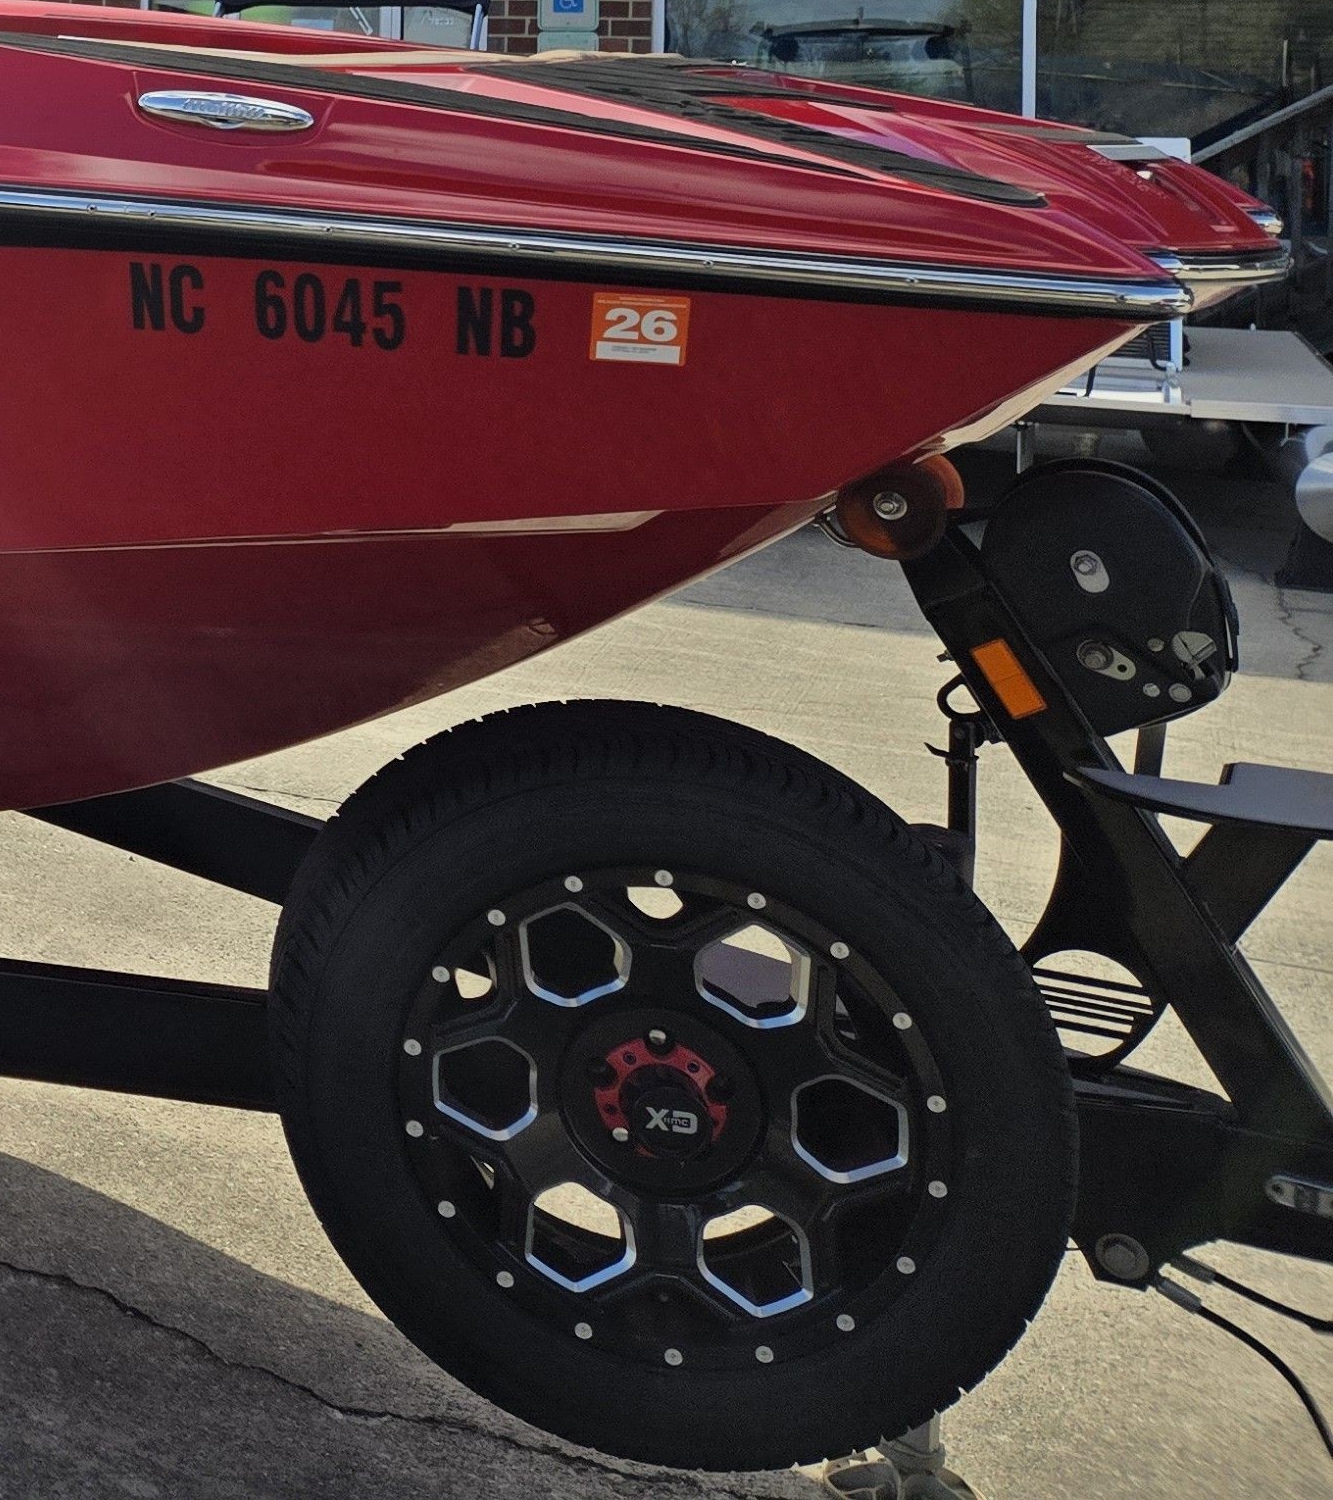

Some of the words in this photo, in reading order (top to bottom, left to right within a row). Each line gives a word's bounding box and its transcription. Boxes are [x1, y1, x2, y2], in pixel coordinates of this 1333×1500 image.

[129, 260, 205, 334] NC
[255, 269, 406, 351] 6045
[456, 285, 537, 359] NB
[602, 307, 678, 342] 26
